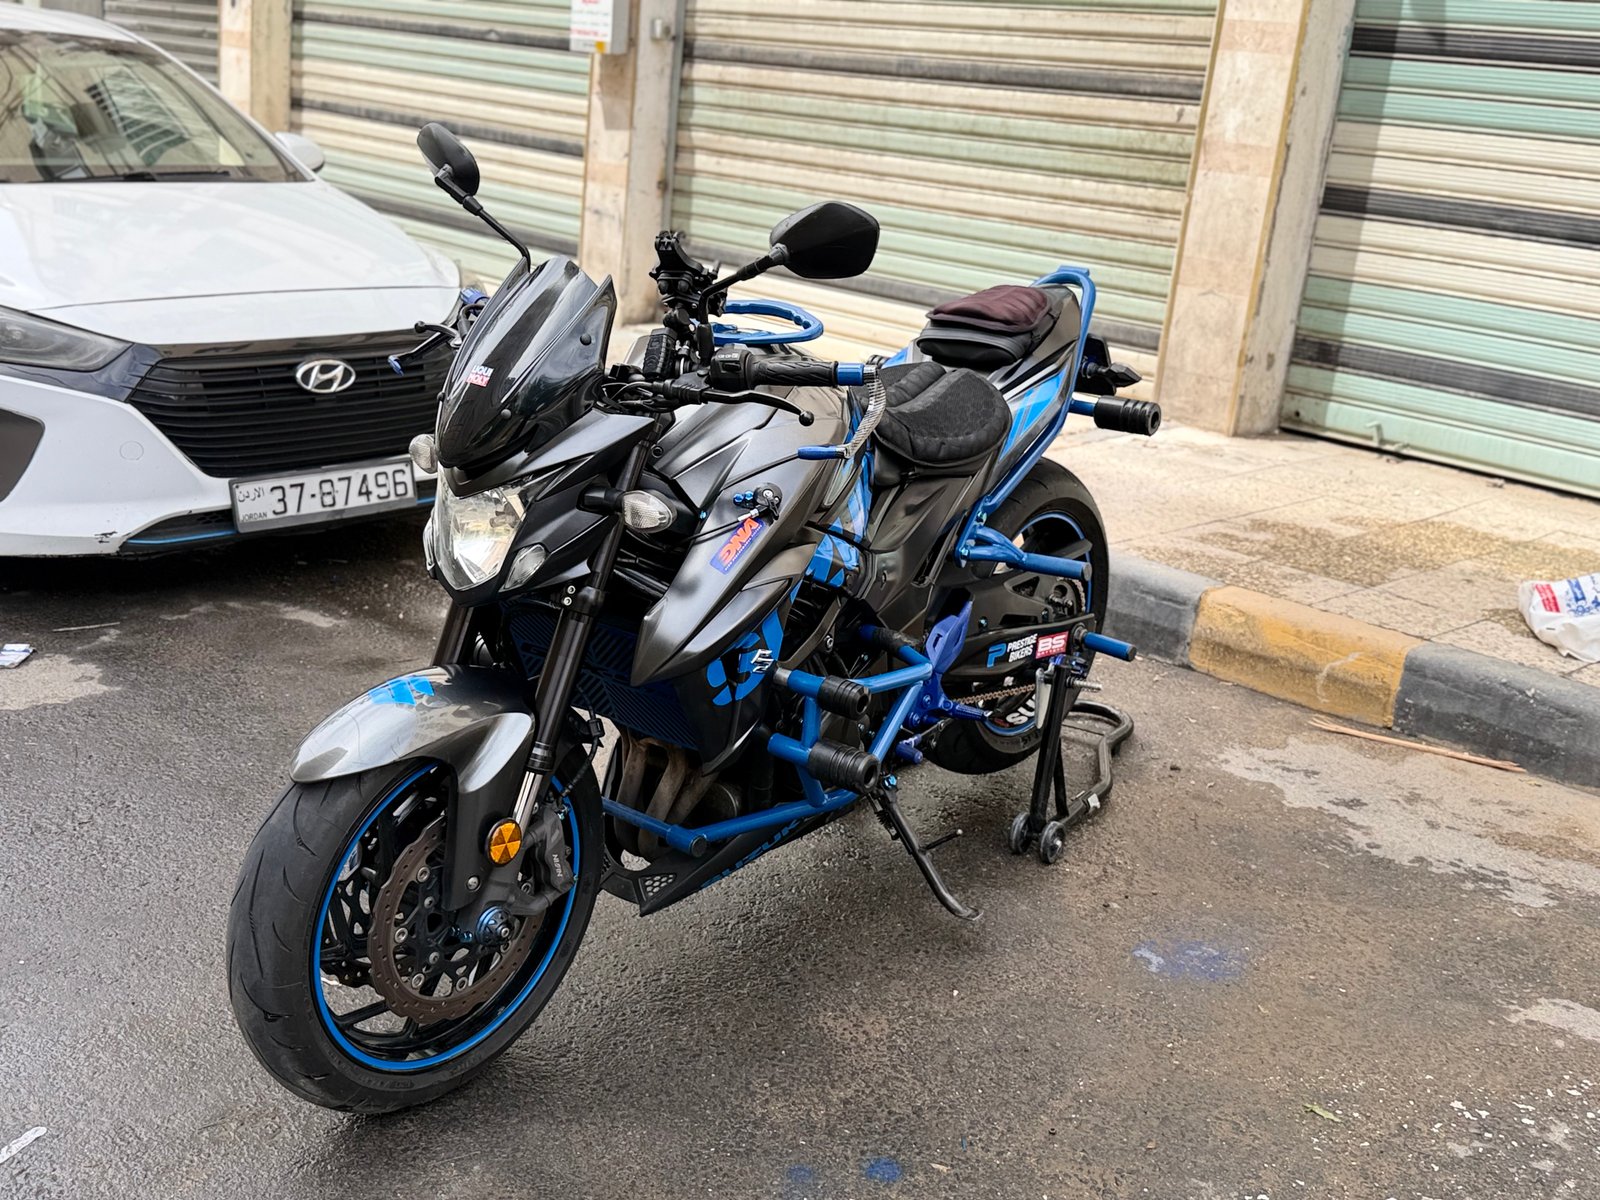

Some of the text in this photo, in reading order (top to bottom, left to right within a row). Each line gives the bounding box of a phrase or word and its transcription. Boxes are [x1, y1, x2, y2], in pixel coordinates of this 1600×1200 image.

[241, 512, 268, 522] JORDAN
[1007, 633, 1038, 653] PRESTIGE
[1037, 634, 1066, 653] BS
[1005, 694, 1036, 725] SU
[700, 817, 802, 888] SUZUK
